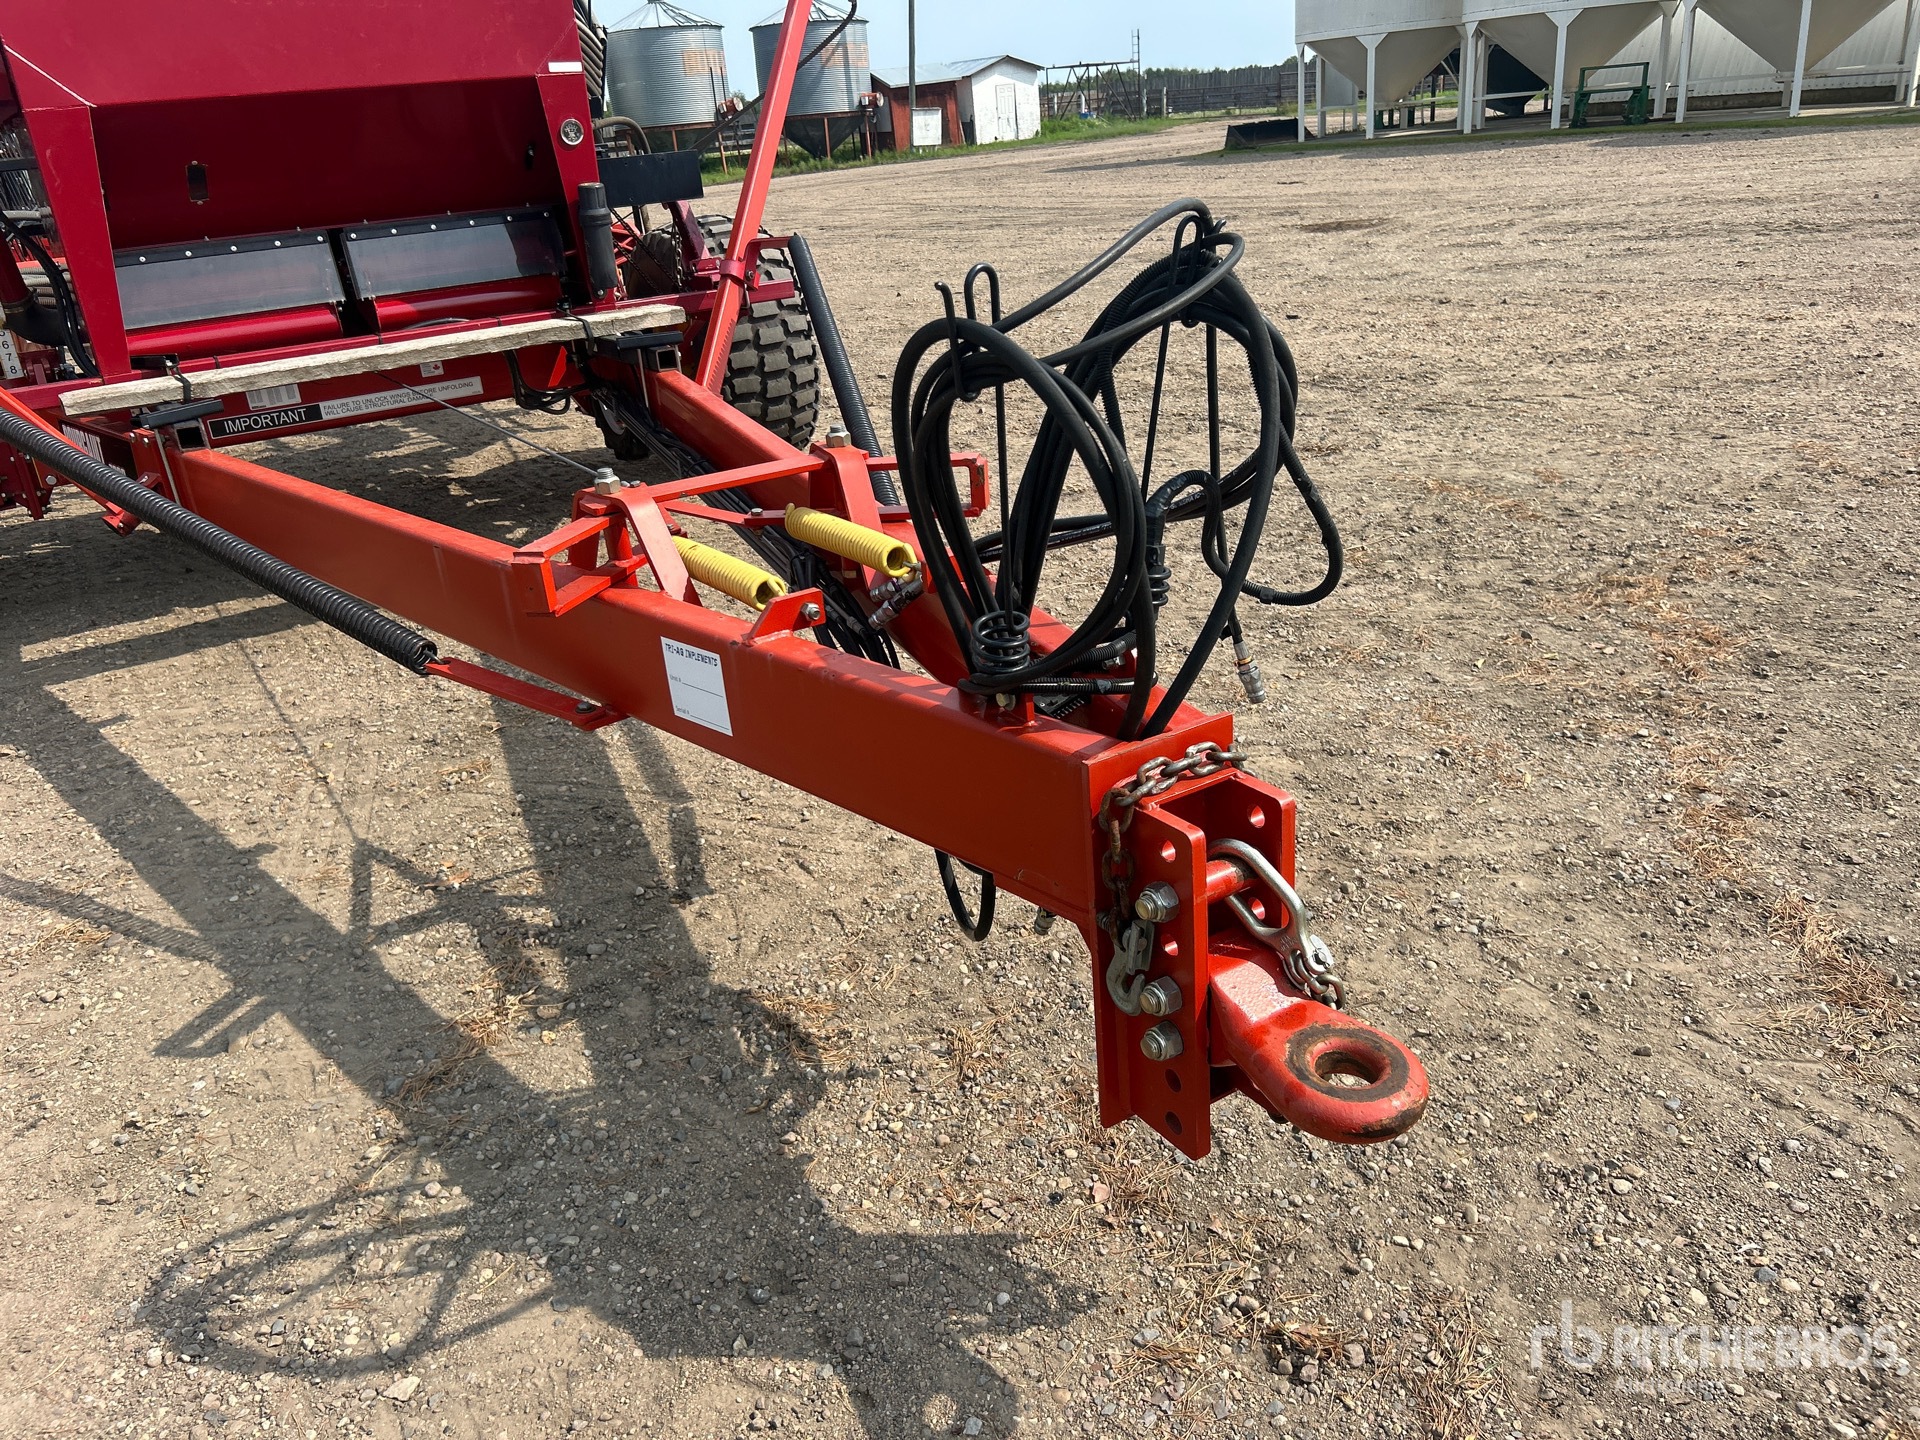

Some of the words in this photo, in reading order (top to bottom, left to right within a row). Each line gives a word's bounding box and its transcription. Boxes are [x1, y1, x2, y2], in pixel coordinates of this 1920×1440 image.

[2, 340, 10, 350] 6
[5, 353, 12, 362] 7
[10, 365, 18, 375] 8
[323, 402, 350, 411] FAILURE
[362, 395, 389, 404] UNLOCK
[389, 391, 411, 400] WINGS
[411, 387, 438, 397] BFORE
[438, 381, 474, 392] UNFOLDING
[324, 409, 341, 417] WILL
[341, 405, 364, 414] CAUSE
[365, 399, 406, 410] STRUCTURAL
[224, 408, 307, 433] IMPORTANT
